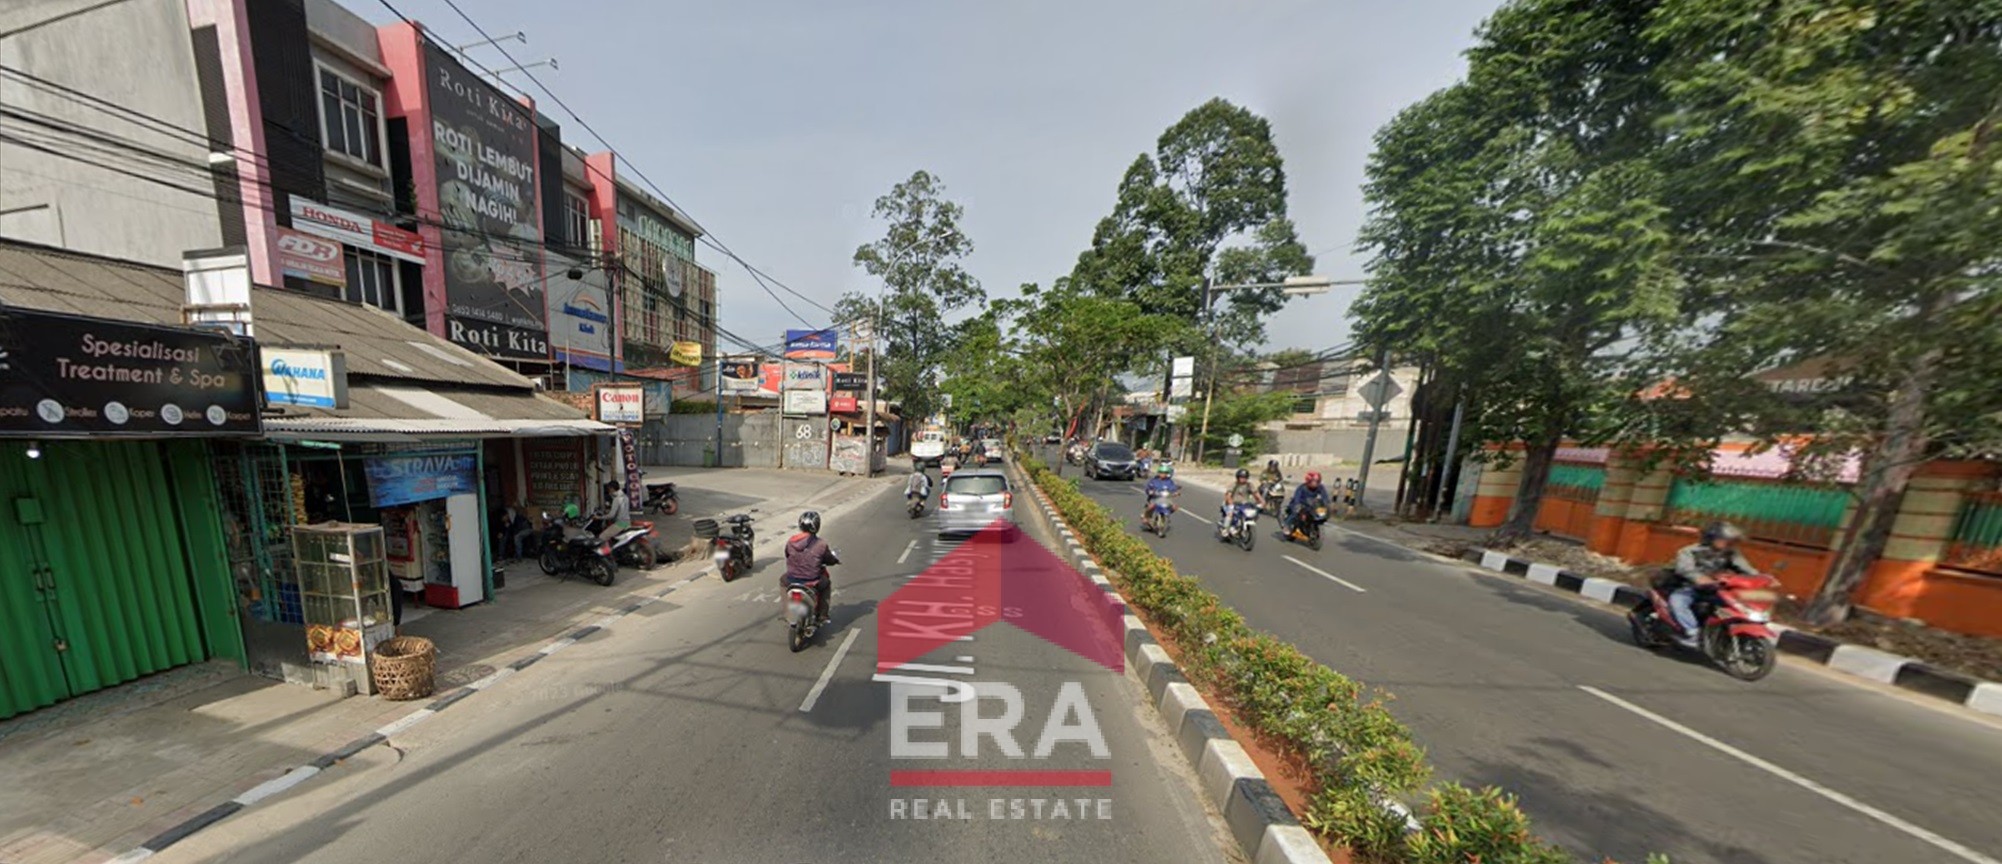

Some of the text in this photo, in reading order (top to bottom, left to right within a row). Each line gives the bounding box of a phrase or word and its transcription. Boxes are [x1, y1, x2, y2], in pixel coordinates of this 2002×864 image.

[440, 67, 524, 131] Roti Kita
[433, 121, 533, 183] ROTI LEMBUT
[457, 160, 520, 202] DIJAMIN
[303, 206, 363, 234] HONDA
[467, 189, 517, 225] NAGIH!
[277, 233, 337, 261] FDR
[81, 333, 200, 362] Spesialisasi
[450, 320, 499, 347] Roti
[508, 330, 547, 354] Kita
[57, 357, 225, 389] Treatment & Spa
[602, 391, 639, 403] Canon
[796, 424, 812, 440] 68
